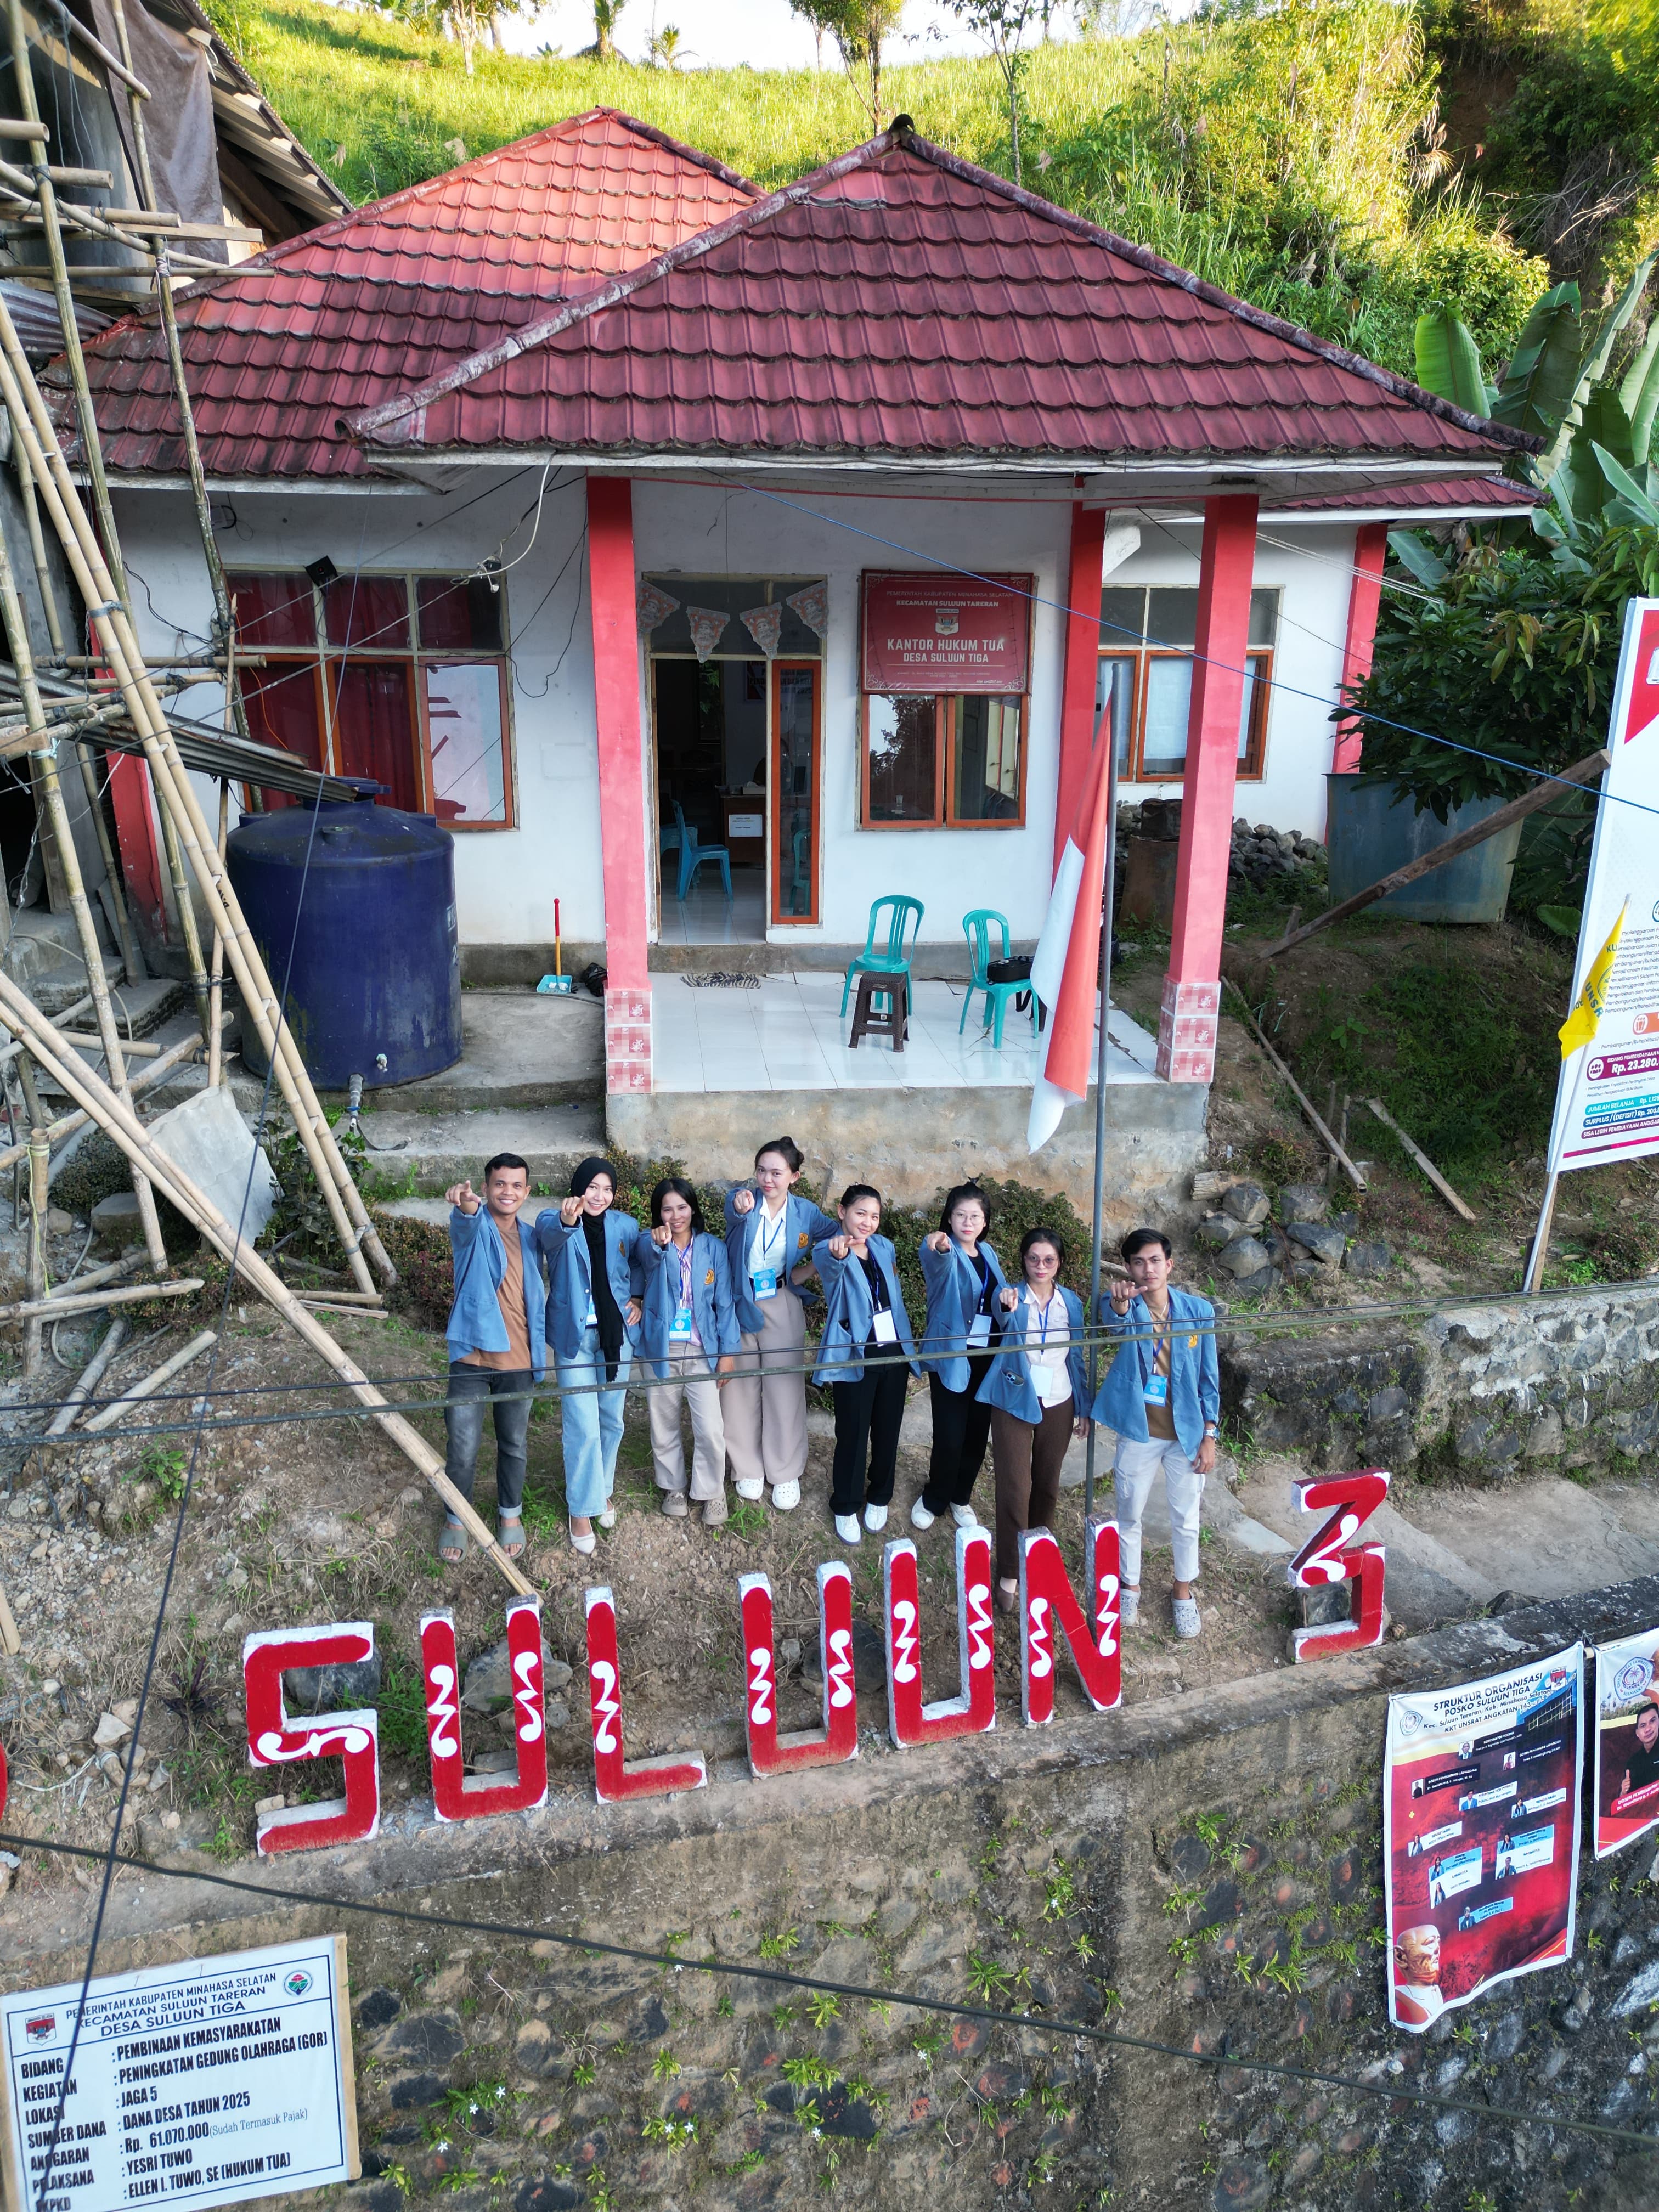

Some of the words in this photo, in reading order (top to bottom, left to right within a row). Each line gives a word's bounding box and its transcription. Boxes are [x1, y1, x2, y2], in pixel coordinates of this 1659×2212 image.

[887, 639, 933, 651] KANTOR
[938, 640, 978, 651] HUKUM
[981, 640, 1005, 652] TUA
[904, 653, 927, 662] DESA
[930, 653, 965, 663] SULUUN
[968, 653, 989, 663] TIGA
[1611, 1063, 1626, 1076] Rp.
[1623, 1051, 1656, 1060] PEMBERDAYAAN
[1585, 1116, 1610, 1125] SURPLUS
[1588, 1104, 1610, 1113] JUMLAH
[1611, 1100, 1634, 1109] BELANJA
[1288, 1468, 1392, 1664] 3
[1434, 1690, 1482, 1711] STRUKTUR
[1485, 1673, 1542, 1697] ORGANISASI
[1440, 1717, 1459, 1727] Suluun
[1485, 1704, 1498, 1712] Kab.
[1500, 1695, 1528, 1708] Minahasa
[1529, 1689, 1550, 1699] Selatan
[1444, 1702, 1474, 1717] POSKO
[1476, 1693, 1509, 1708] SULUUN
[1512, 1686, 1530, 1698] TIGA
[1459, 1717, 1482, 1729] UNSRAT
[1483, 1707, 1518, 1720] ANGKATAN
[1520, 1701, 1531, 1710] 143
[78, 2006, 156, 2028] KECAMATAN
[161, 1996, 207, 2011] SULUUN
[211, 1986, 266, 2002] TARERAN
[129, 1989, 183, 2007] KABUPATEN
[187, 1980, 234, 1998] MINAHASA
[236, 1973, 276, 1988] SELATAN
[101, 2019, 142, 2036] DESA
[146, 2008, 204, 2027] SULUUN
[210, 2001, 245, 2016] TIGA
[21, 2057, 64, 2079] BIDANG
[117, 2034, 181, 2061] PEMBINAAN
[183, 2017, 281, 2048] KEMASYARAKATAN
[23, 2079, 77, 2103] KEGIATAN
[119, 2057, 194, 2084] PENINGKATAN
[197, 2047, 239, 2069] GEDUNG
[241, 2038, 295, 2060] OLAHRAGA
[298, 2031, 328, 2050] (GOR)
[121, 2087, 146, 2108] JAGA
[150, 2085, 158, 2101] 5
[28, 2126, 74, 2149] SUMBER
[76, 2120, 106, 2140] DANA
[123, 2111, 153, 2130] DANA
[155, 2104, 183, 2124] DESA
[184, 2097, 220, 2118] TAHUN
[222, 2091, 251, 2110] 2025
[125, 2137, 143, 2153] Rp.
[241, 2115, 281, 2129] Termasuk
[283, 2108, 308, 2123] Pajak)
[126, 2155, 158, 2176] YESRI
[160, 2148, 193, 2169] TUWO
[128, 2178, 158, 2199] ELLEN
[161, 2177, 167, 2192] I.
[169, 2169, 205, 2191] TUWO,
[206, 2166, 219, 2183] SE
[221, 2157, 264, 2180] (HUKUM
[266, 2152, 291, 2171] TUA)
